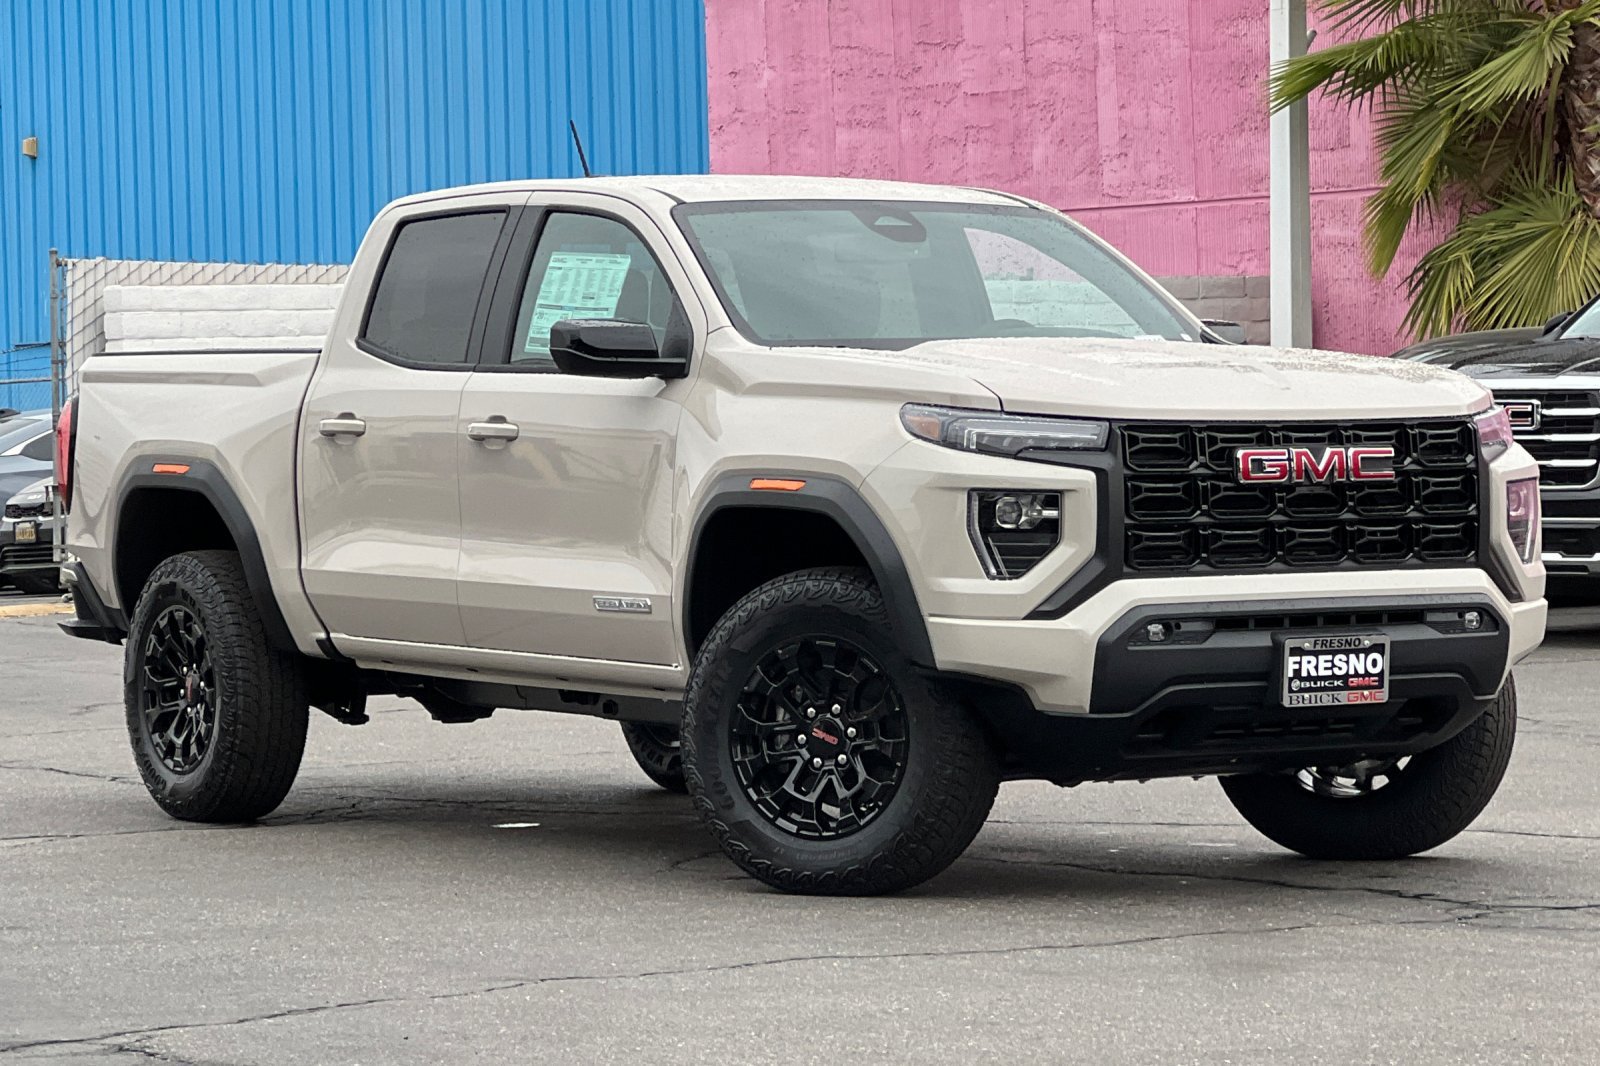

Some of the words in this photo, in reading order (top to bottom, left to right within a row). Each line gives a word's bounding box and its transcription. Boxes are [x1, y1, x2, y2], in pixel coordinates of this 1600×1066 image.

[1236, 447, 1395, 484] GMC
[1313, 638, 1362, 649] FRESNO
[1288, 652, 1383, 678] FRESNO
[1301, 680, 1344, 688] BUICK
[1348, 677, 1379, 687] GMC
[1288, 693, 1342, 706] BUICK
[1346, 691, 1384, 703] GMC
